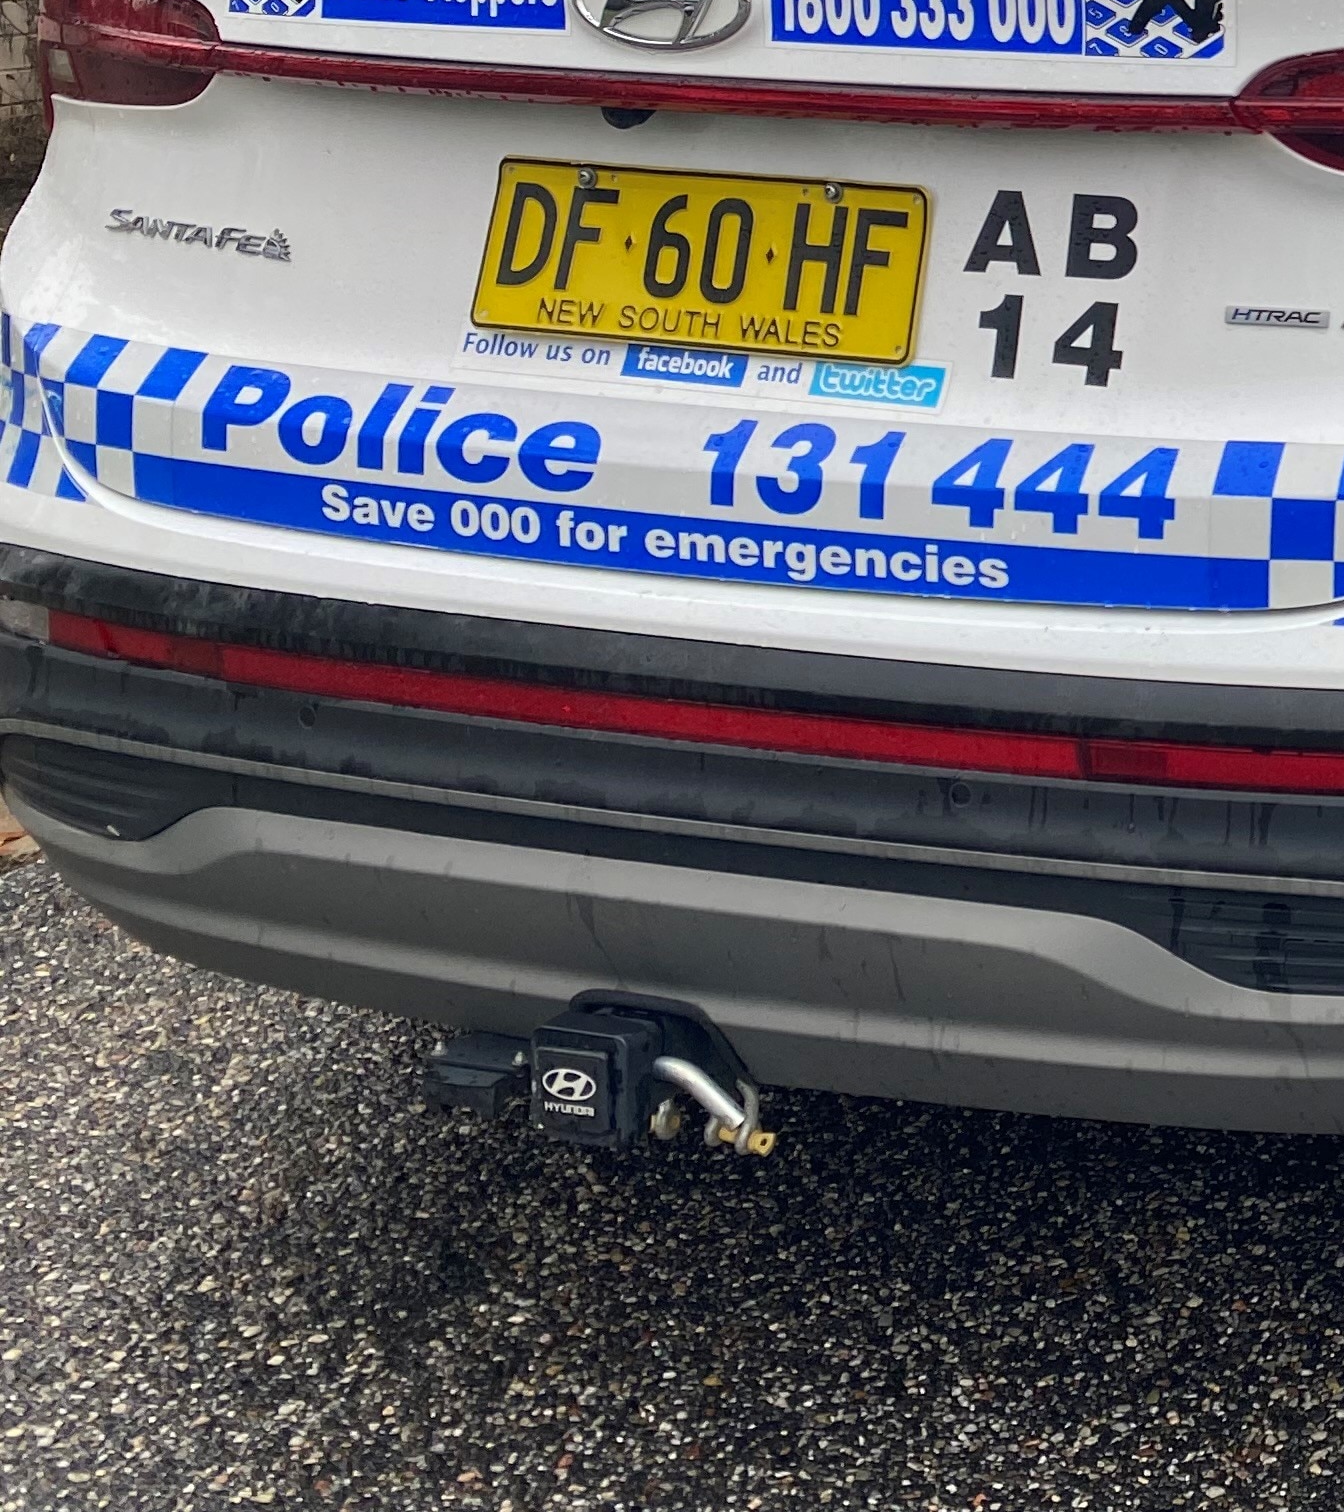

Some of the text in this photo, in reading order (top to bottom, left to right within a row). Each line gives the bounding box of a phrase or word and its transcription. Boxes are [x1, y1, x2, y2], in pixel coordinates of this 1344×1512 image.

[105, 208, 213, 248] SANTA
[496, 182, 908, 316] DF 60 HF
[963, 189, 1139, 280] AB
[537, 297, 842, 349] NEW SOUTH WALES
[978, 294, 1123, 388] 14
[1231, 308, 1322, 324] HTRAC
[462, 332, 936, 402] Follow us on facebook and twitter
[202, 365, 1181, 541] Police 131 444
[321, 484, 1010, 588] Save 000 for emergencies
[544, 1101, 595, 1117] HYUNDAI
